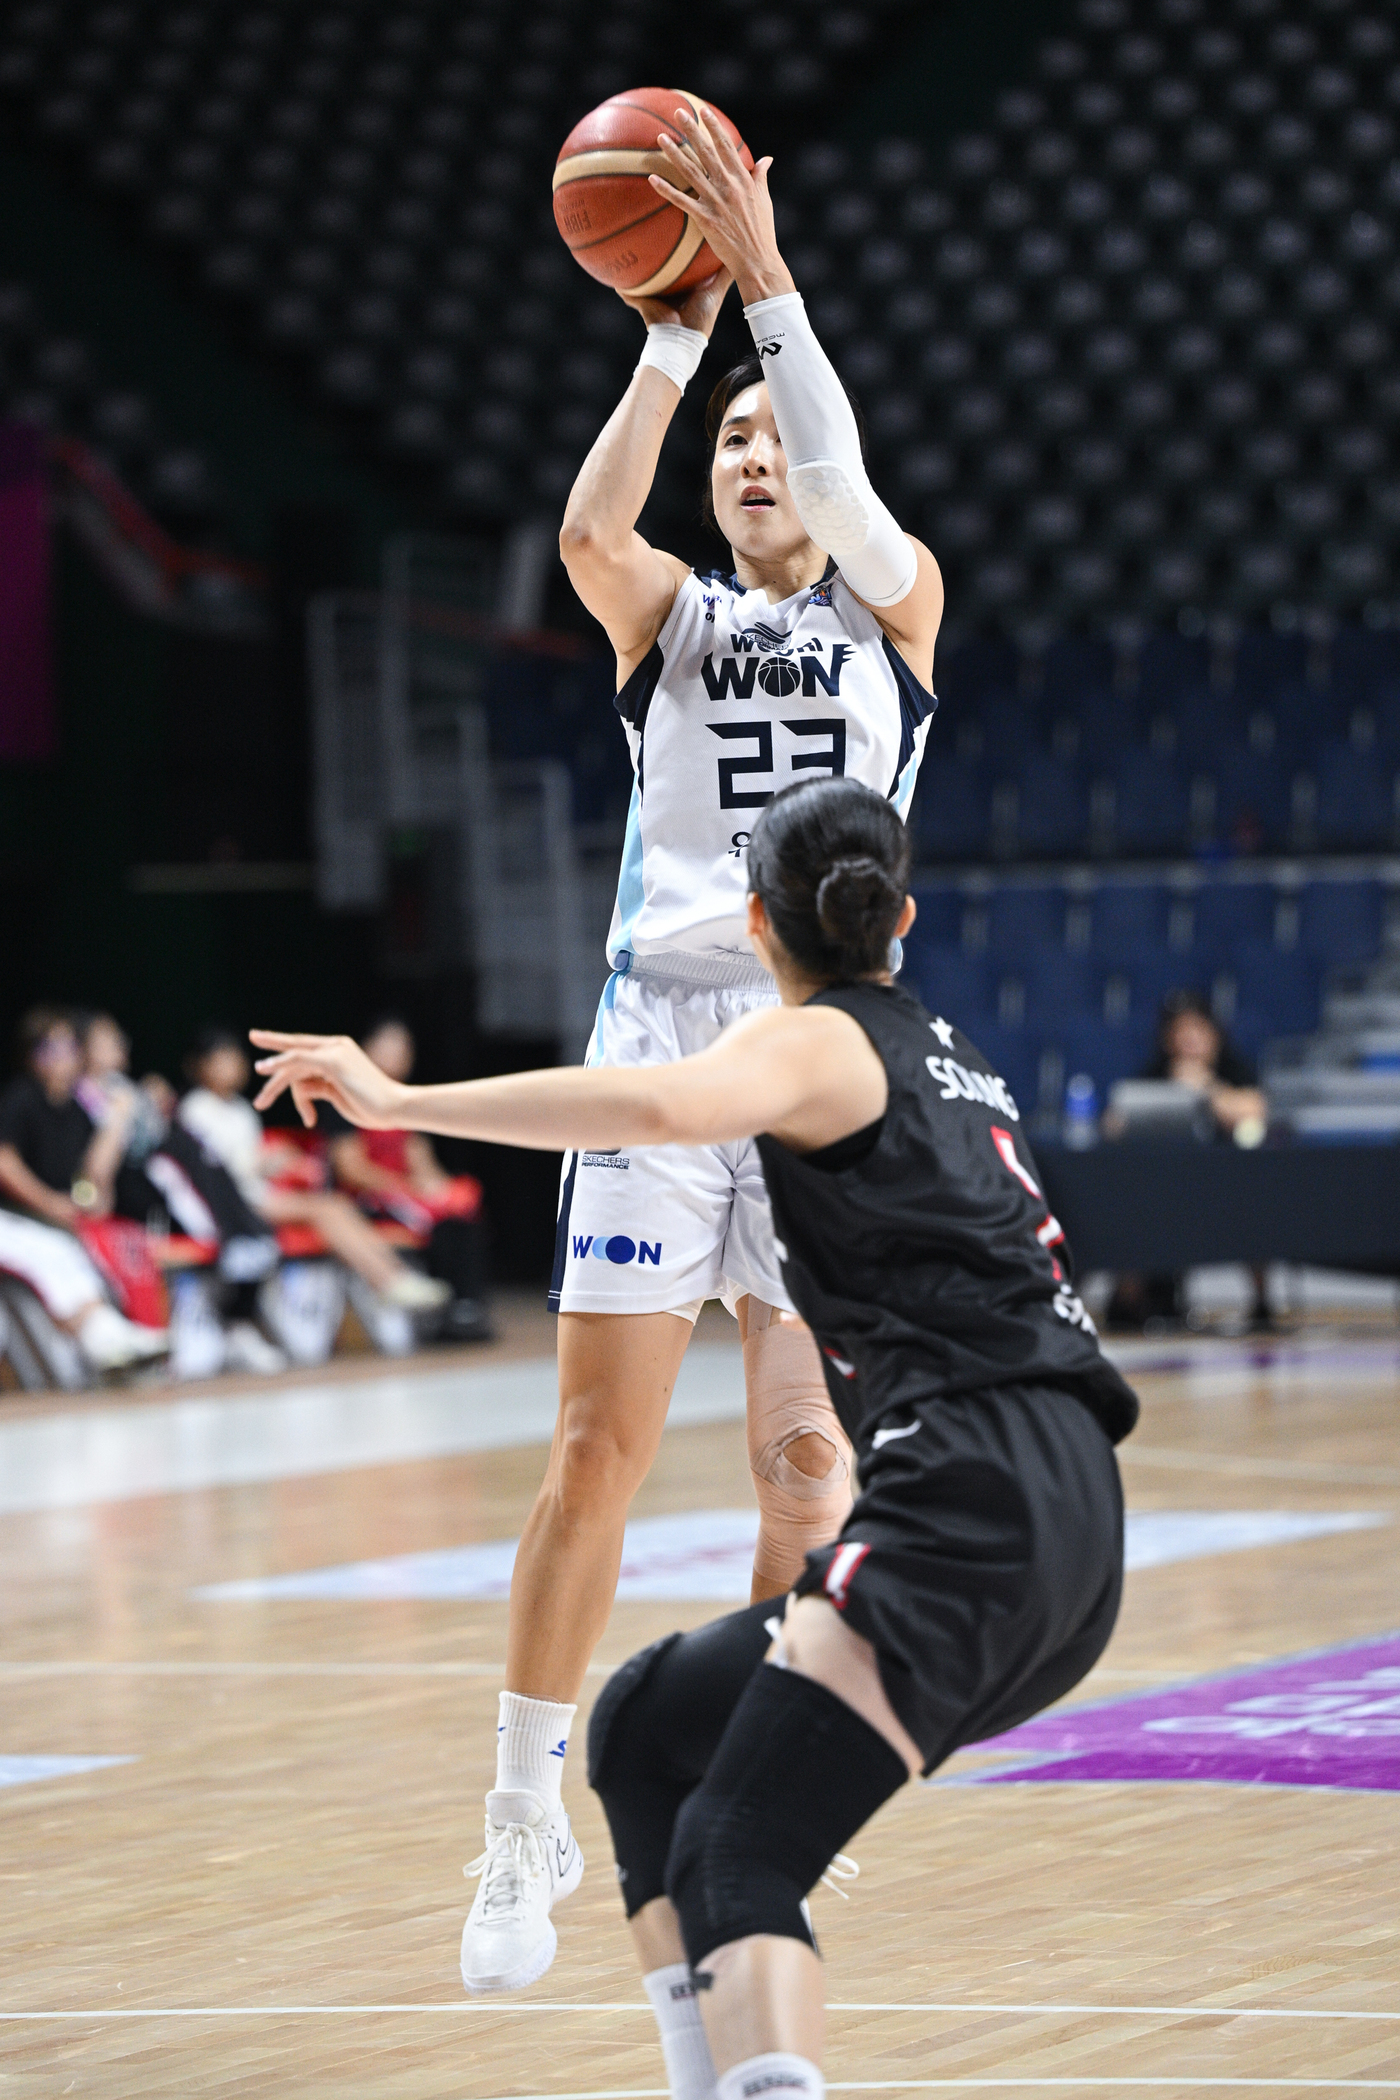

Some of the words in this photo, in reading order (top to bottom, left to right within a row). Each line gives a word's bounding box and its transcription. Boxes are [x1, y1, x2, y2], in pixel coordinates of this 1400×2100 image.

[700, 643, 857, 701] WON
[705, 719, 846, 809] 23
[925, 1055, 1019, 1121] SONG
[581, 1162, 629, 1170] PERFORMANCE
[582, 1155, 630, 1165] SKECHERS
